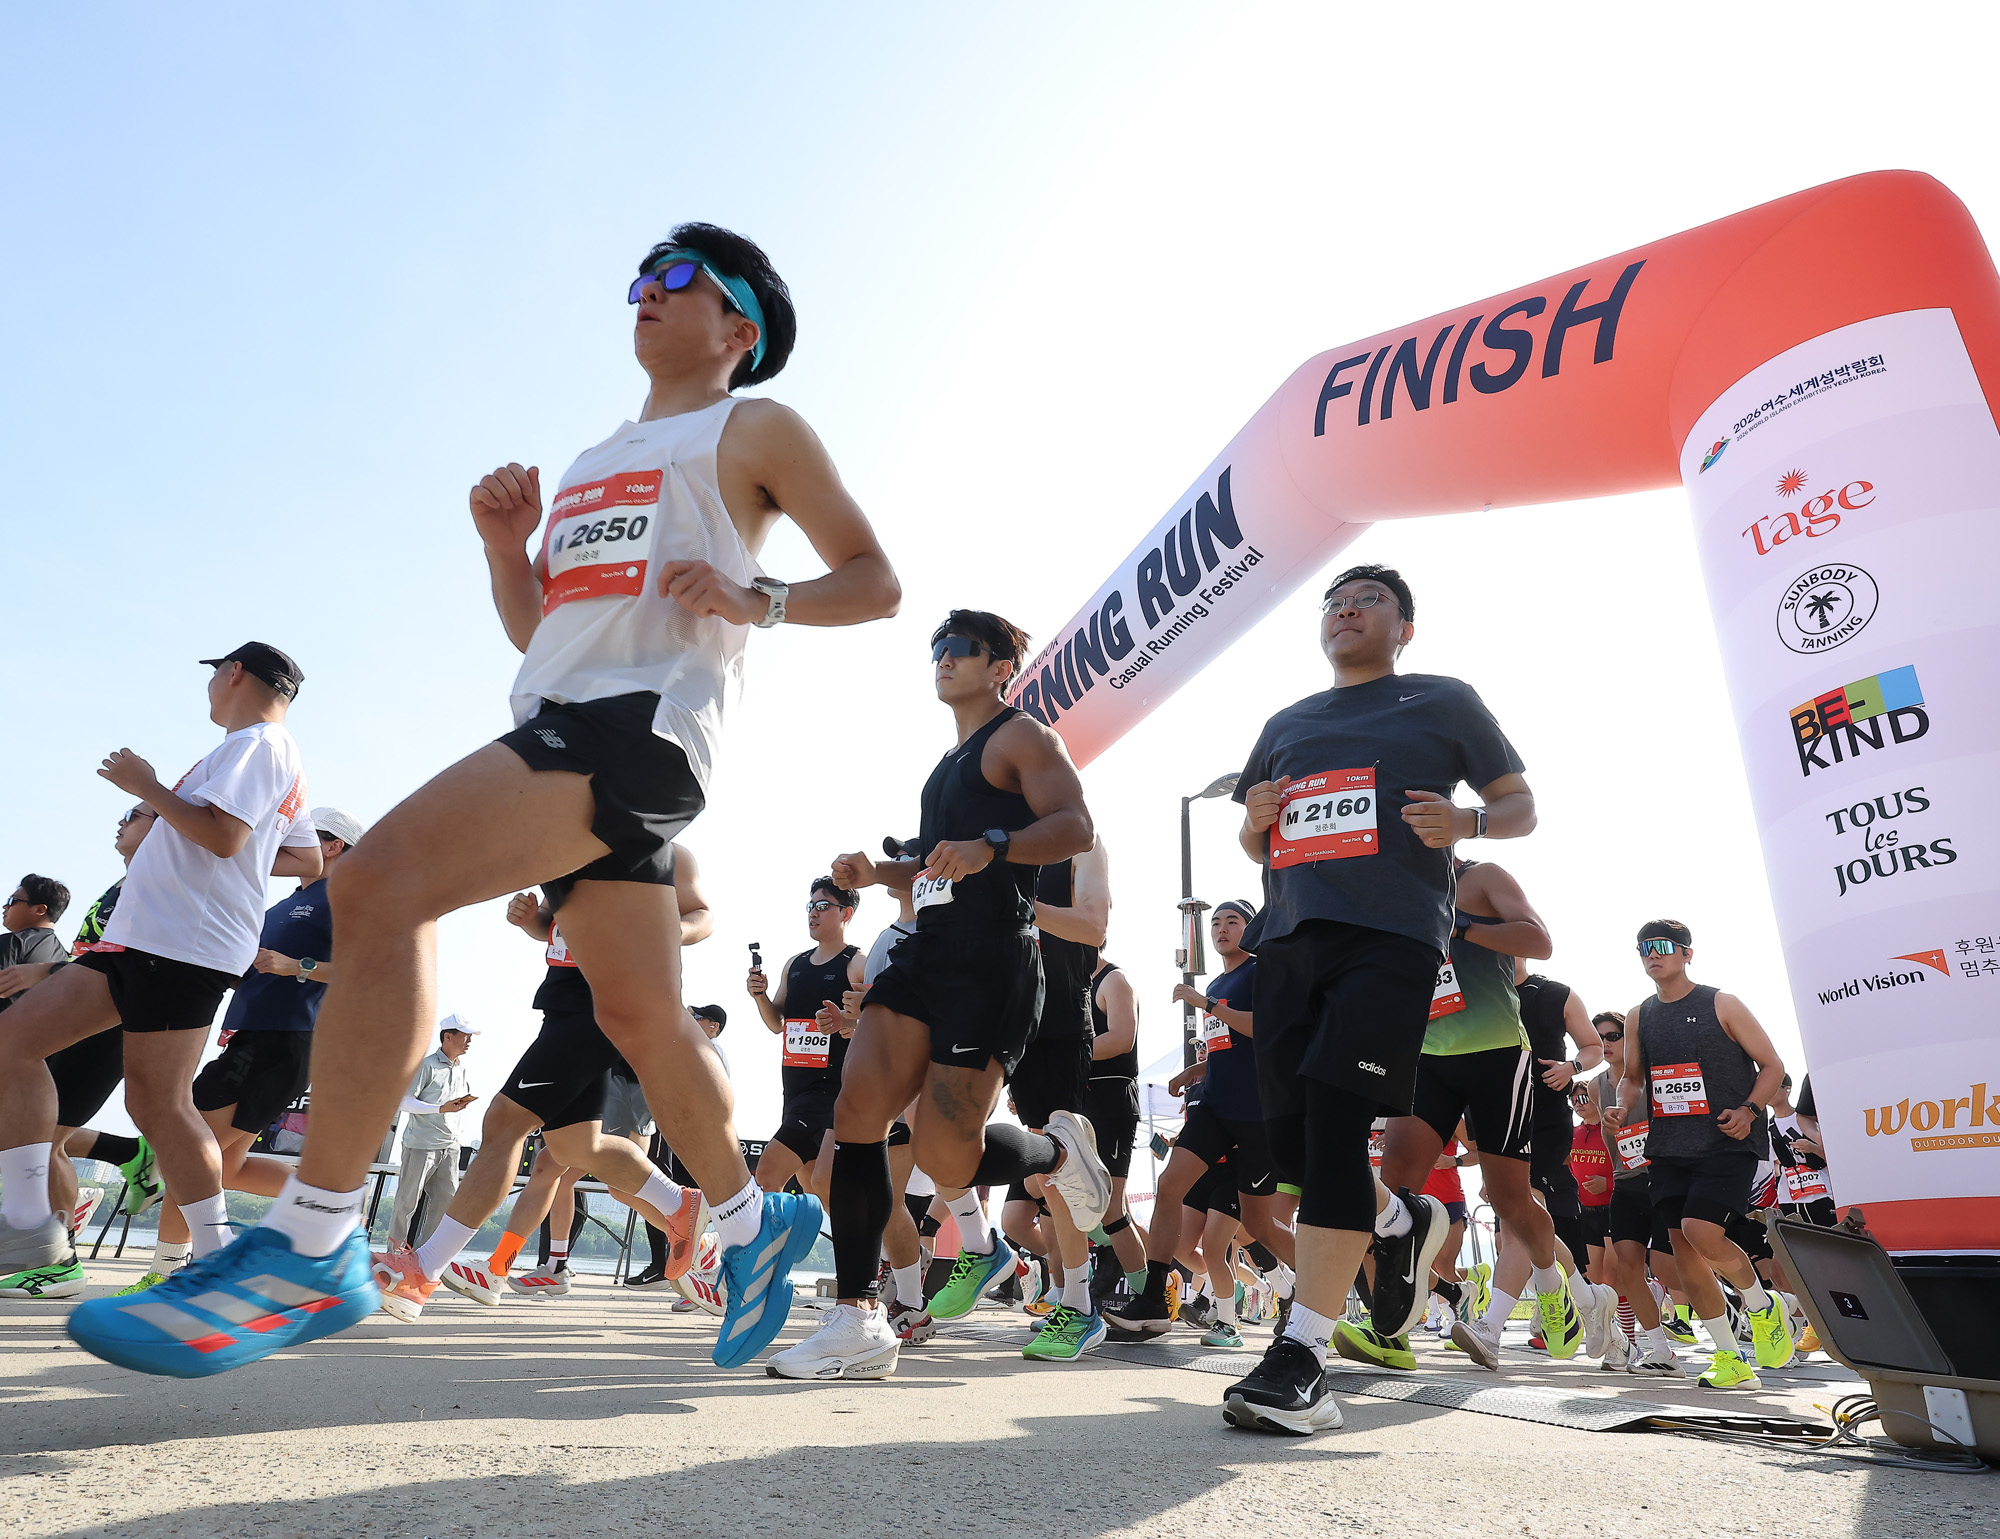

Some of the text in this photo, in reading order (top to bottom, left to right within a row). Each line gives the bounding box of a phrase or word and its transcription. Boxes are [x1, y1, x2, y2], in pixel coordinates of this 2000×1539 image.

[1314, 259, 1647, 437] FINISH
[1733, 354, 1885, 434] 2026여수세계섬박람회
[1736, 367, 1887, 442] 2026 WORLD ISLAND EXHIBITION YEOSU KOREA
[625, 484, 655, 494] 10km
[567, 515, 648, 549] 2650
[1742, 480, 1877, 555] Tage
[1008, 464, 1244, 728] RNING RUN
[1784, 568, 1858, 611] SUNBODY
[1109, 546, 1264, 690] Casual Running Festival
[1801, 615, 1863, 649] TANNING
[1796, 706, 1930, 777] KIND
[1307, 777, 1328, 789] RUN
[1346, 774, 1369, 783] 10km
[1285, 796, 1371, 827] M 2160
[1825, 787, 1930, 836] TOUS
[1865, 826, 1899, 852] les
[1834, 838, 1958, 897] JOURS
[1954, 936, 2000, 956] 후원
[1818, 970, 1925, 1006] World Vision
[789, 1035, 828, 1047] M 1906
[1358, 1061, 1387, 1076] adidas
[1654, 1081, 1702, 1095] M 2659
[1863, 1083, 2000, 1137] work
[1620, 1144, 1628, 1152] M
[1914, 1136, 1975, 1148] OUTDOOR
[1797, 1173, 1820, 1183] 2007
[1843, 1297, 1853, 1309] 3
